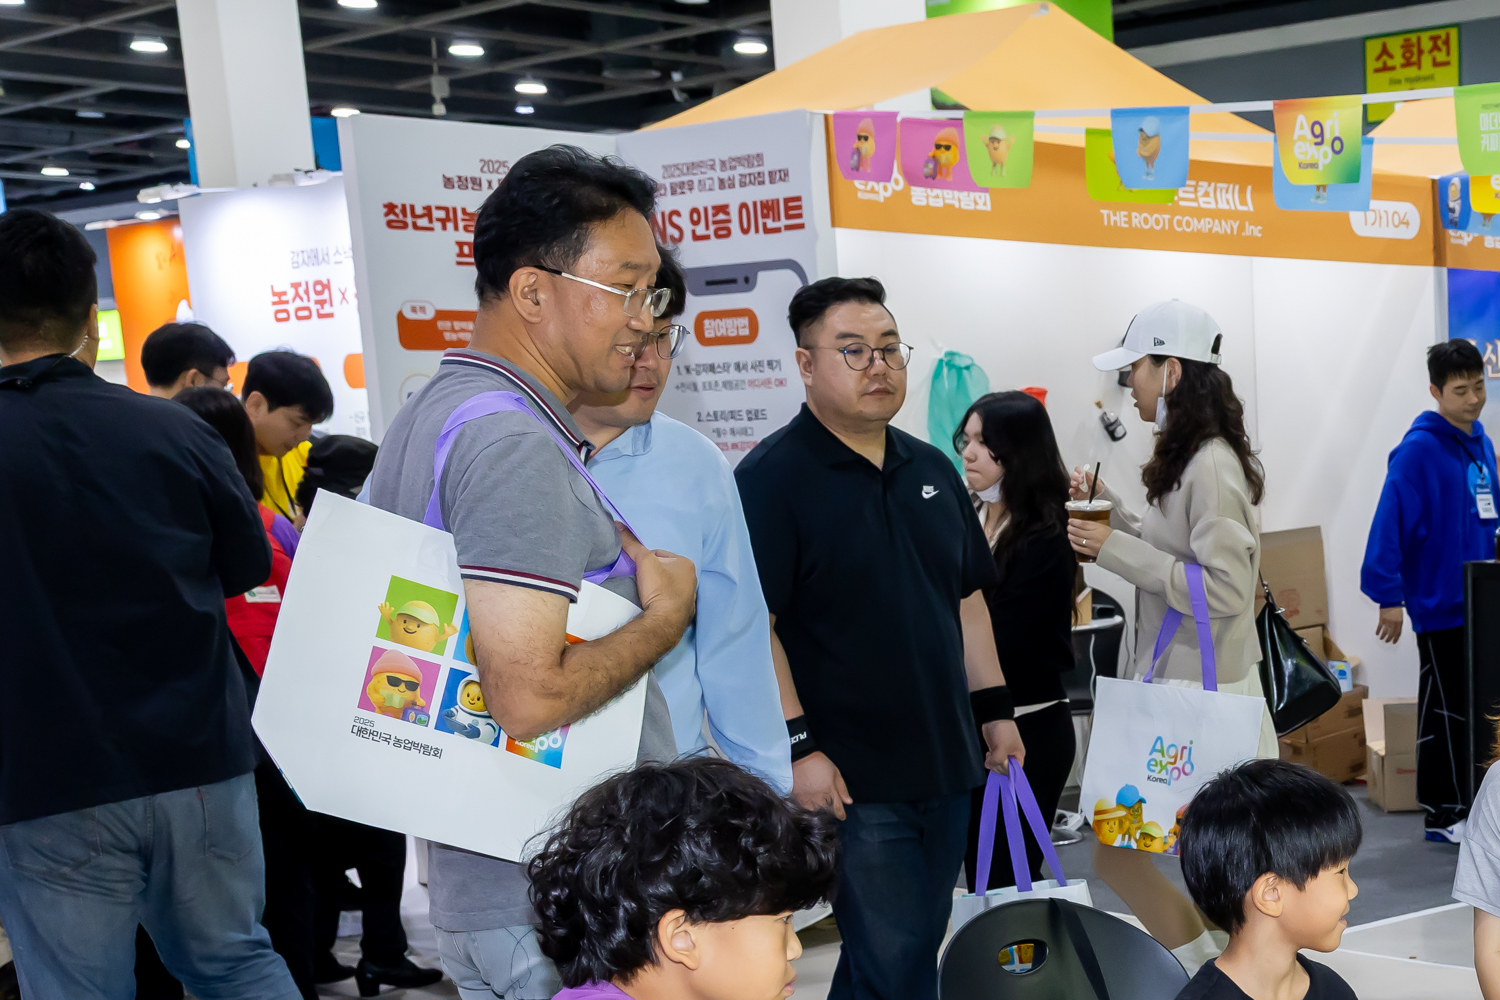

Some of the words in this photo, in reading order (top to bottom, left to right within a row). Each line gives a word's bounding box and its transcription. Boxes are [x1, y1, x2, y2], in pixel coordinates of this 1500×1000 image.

[1373, 31, 1451, 73] 소화전
[1293, 111, 1340, 146] Agri
[479, 159, 510, 175] 2025
[1294, 136, 1344, 171] expo
[1173, 180, 1254, 212] 트컴퍼니
[652, 208, 685, 245] NS
[689, 203, 732, 242] 인증
[738, 195, 806, 235] 이벤트
[1100, 209, 1129, 228] THE
[1131, 211, 1172, 231] ROOT
[1173, 215, 1239, 236] COMPANY
[270, 278, 335, 323] 농정원
[703, 316, 749, 338] 참여방법
[353, 715, 376, 728] 2025
[351, 724, 392, 745] 대한민국
[392, 736, 443, 760] 농업박람회
[531, 733, 563, 754] po
[1149, 735, 1194, 766] Agri
[1147, 757, 1195, 786] expo
[1147, 774, 1168, 785] Korea
